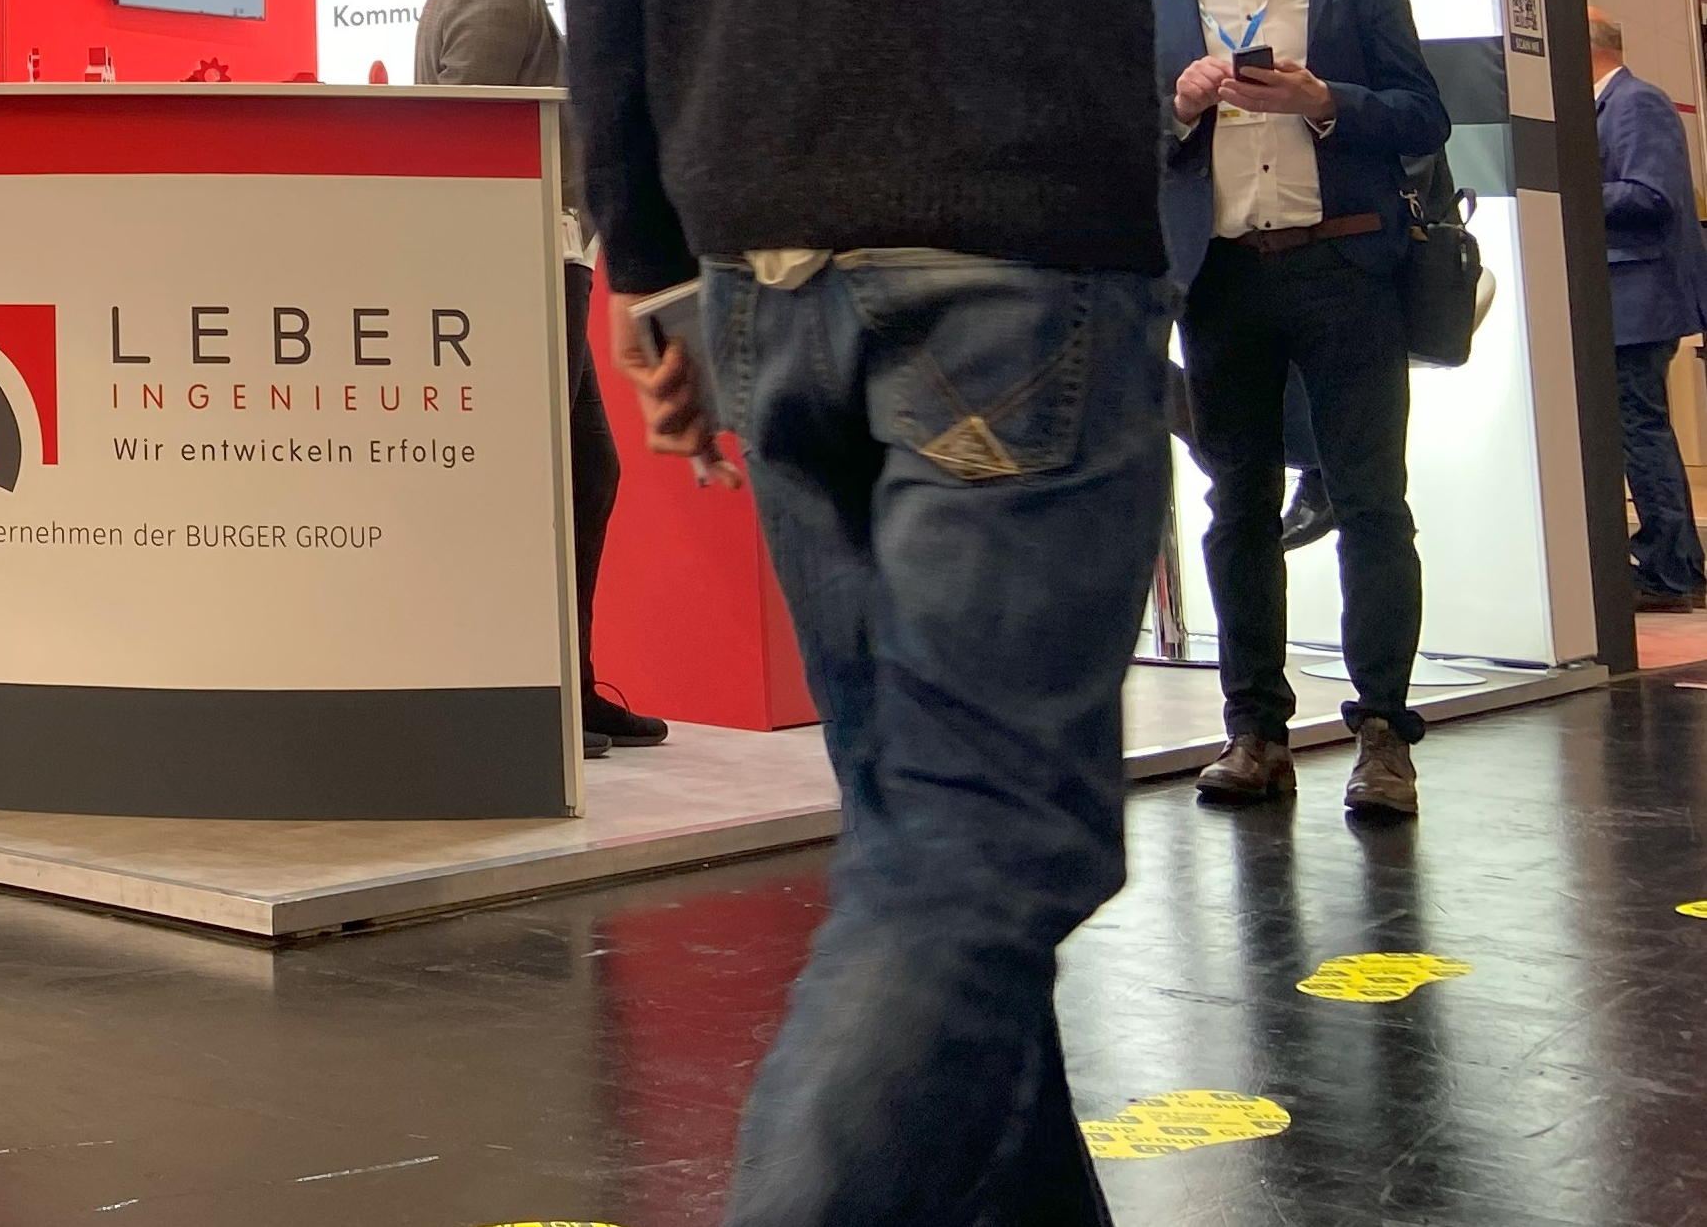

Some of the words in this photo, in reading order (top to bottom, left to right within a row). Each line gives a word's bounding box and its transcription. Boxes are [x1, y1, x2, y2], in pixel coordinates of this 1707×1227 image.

[111, 305, 472, 367] LEBER
[111, 383, 474, 412] INGENIEURE
[113, 437, 164, 462] Wir
[181, 437, 353, 463] entwickeln
[370, 438, 476, 469] Erfolge
[133, 522, 176, 548] der
[186, 524, 287, 549] BURGER
[295, 525, 383, 549] GROUP
